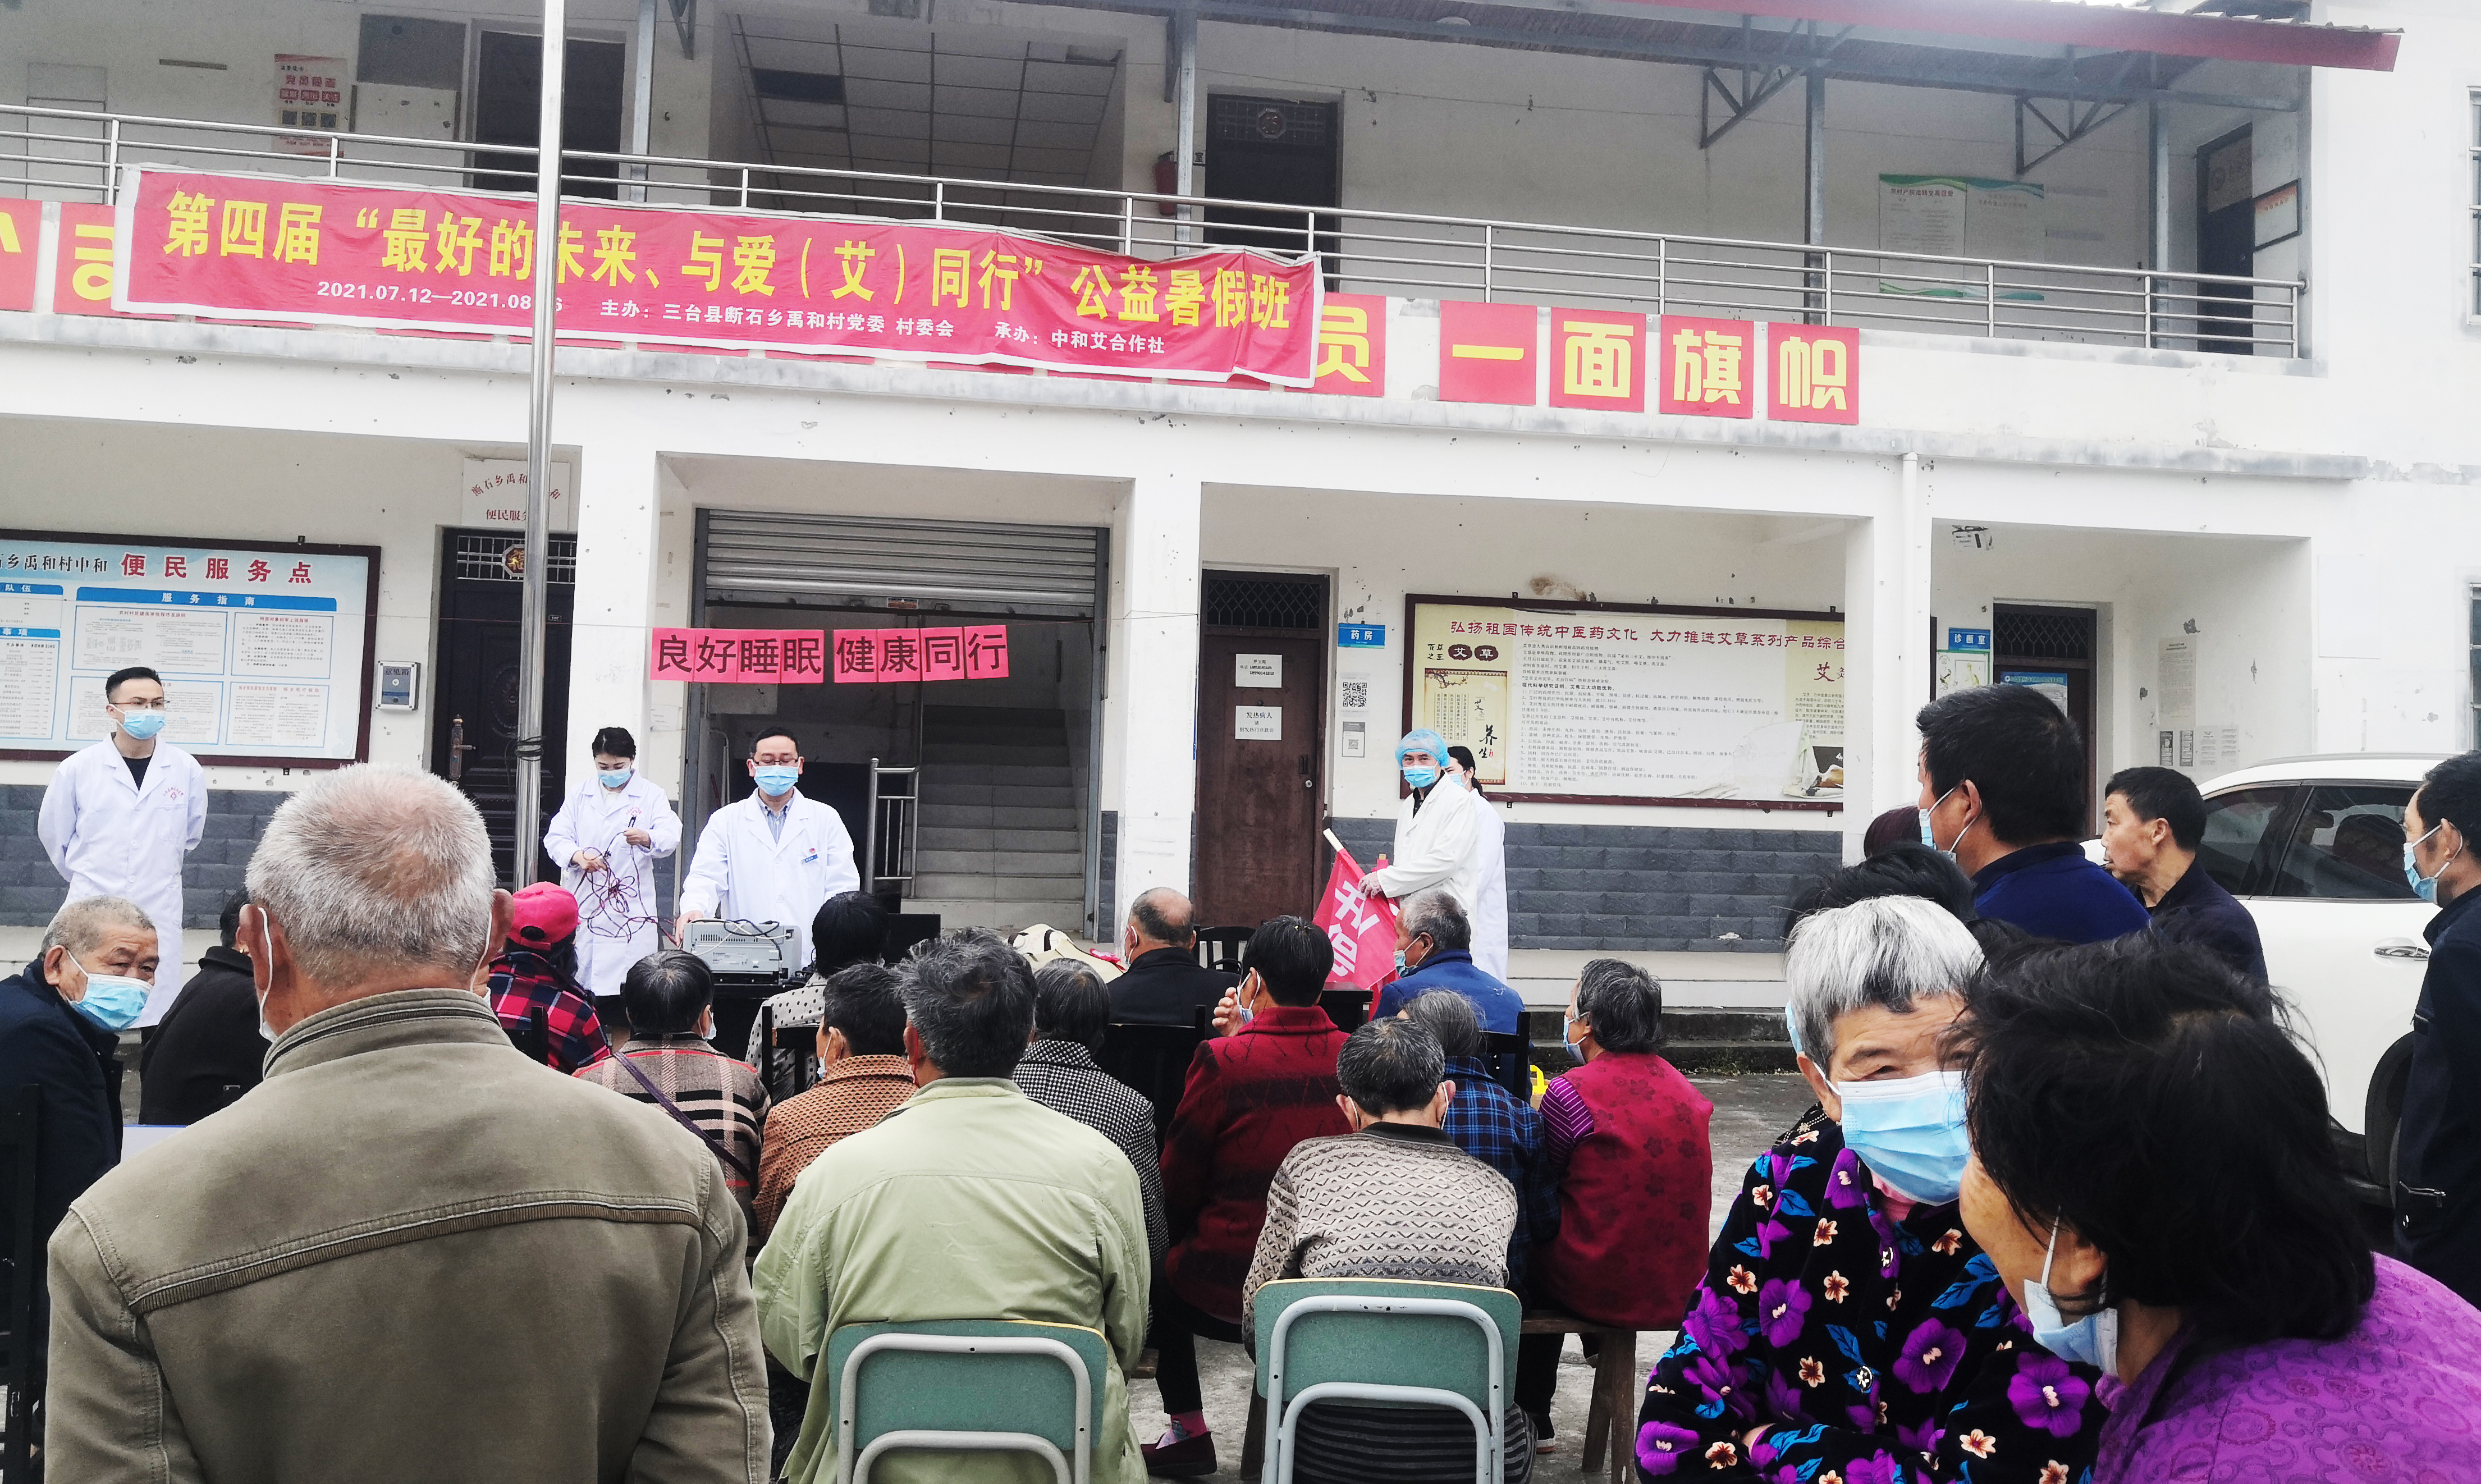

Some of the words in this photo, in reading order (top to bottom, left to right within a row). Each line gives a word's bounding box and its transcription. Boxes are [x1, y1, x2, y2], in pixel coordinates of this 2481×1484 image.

[163, 190, 323, 266] 第四届
[1070, 263, 1290, 330] 公益暑假班
[896, 317, 954, 338] 村委会
[994, 322, 1166, 355] 承办：中和艾合作社
[121, 553, 313, 584] 便民服务点
[161, 592, 256, 607] 服务指南
[1351, 629, 1374, 641] 药房
[1450, 621, 1638, 641] 弘扬祖国传统中医药文化
[1954, 633, 1985, 645] 诊断室
[657, 634, 822, 674] 良好睡眠
[836, 633, 1006, 674] 健康同行
[1453, 647, 1494, 659] 艾草
